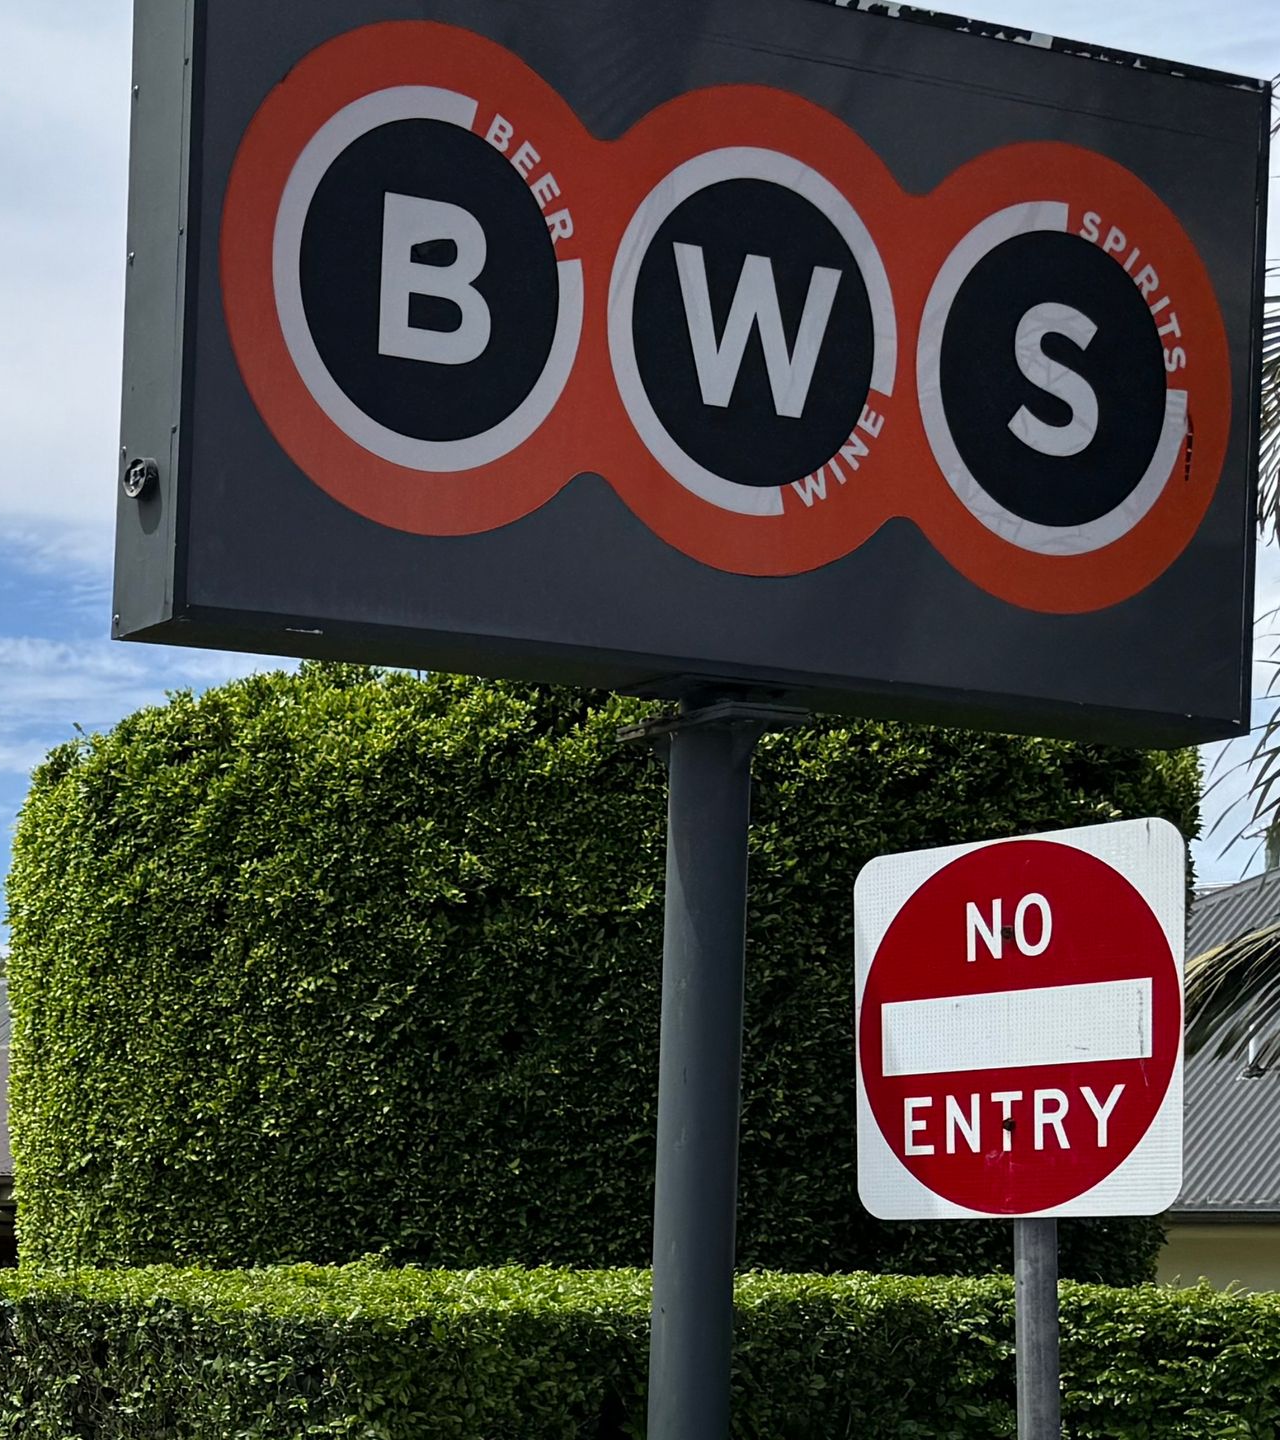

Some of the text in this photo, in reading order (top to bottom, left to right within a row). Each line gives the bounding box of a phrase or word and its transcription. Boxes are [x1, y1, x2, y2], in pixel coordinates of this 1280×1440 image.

[484, 113, 574, 245] BEER
[378, 191, 1100, 458] BWS
[1079, 211, 1186, 372] SPIRITS
[790, 403, 885, 508] WINE
[966, 892, 1052, 962] NO
[904, 1084, 1126, 1156] ENTRY
